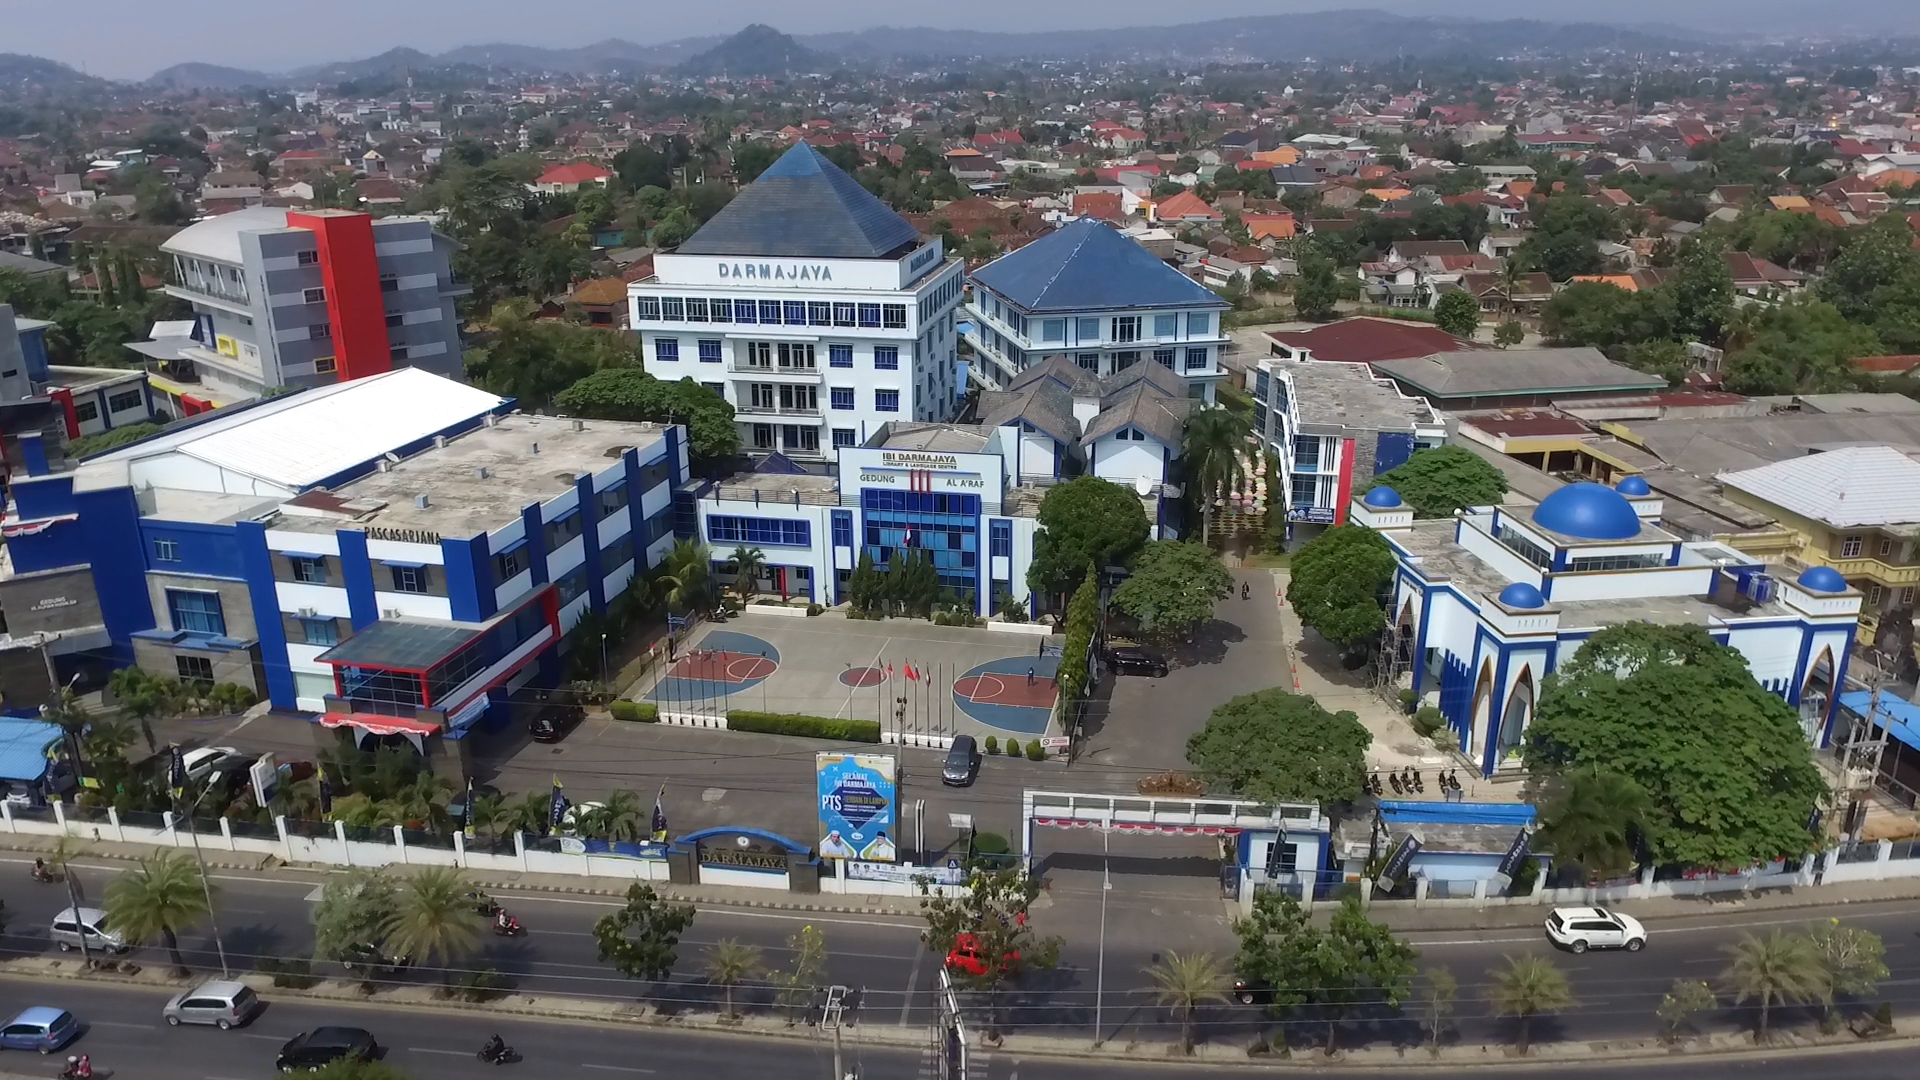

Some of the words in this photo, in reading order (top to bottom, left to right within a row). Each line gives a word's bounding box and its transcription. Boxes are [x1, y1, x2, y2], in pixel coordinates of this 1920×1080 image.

[718, 263, 833, 281] DARMAJAYA
[882, 452, 896, 461] IBI
[898, 453, 957, 463] DARMAJAYA
[860, 474, 895, 483] GEDUNG
[946, 478, 958, 487] AL
[960, 479, 984, 488] A'RAF
[364, 526, 441, 545] PASCASARJANA
[822, 795, 842, 811] PTS
[701, 853, 787, 869] DARMAJAYA
